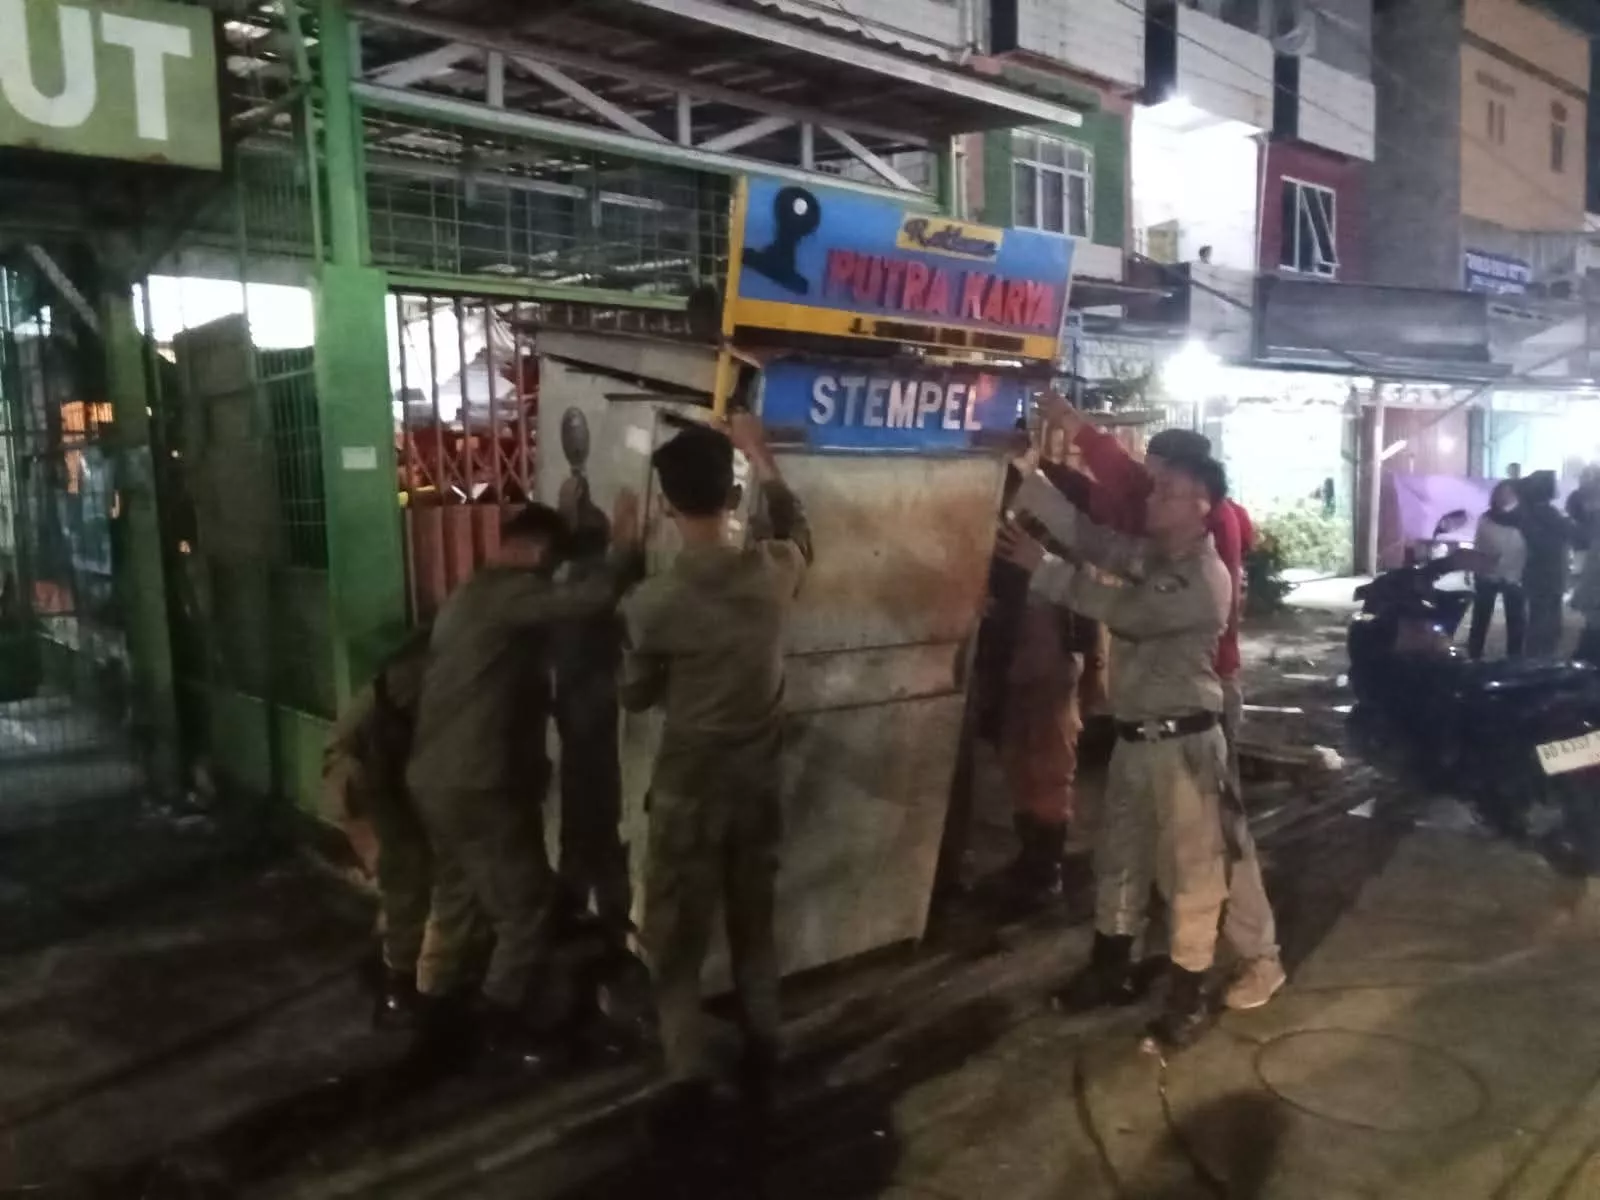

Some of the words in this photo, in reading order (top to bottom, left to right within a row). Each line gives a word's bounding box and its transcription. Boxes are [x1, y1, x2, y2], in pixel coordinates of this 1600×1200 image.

[823, 248, 949, 316] PUTRA
[960, 270, 1057, 331] KARYA
[809, 373, 983, 432] STEMPEL
